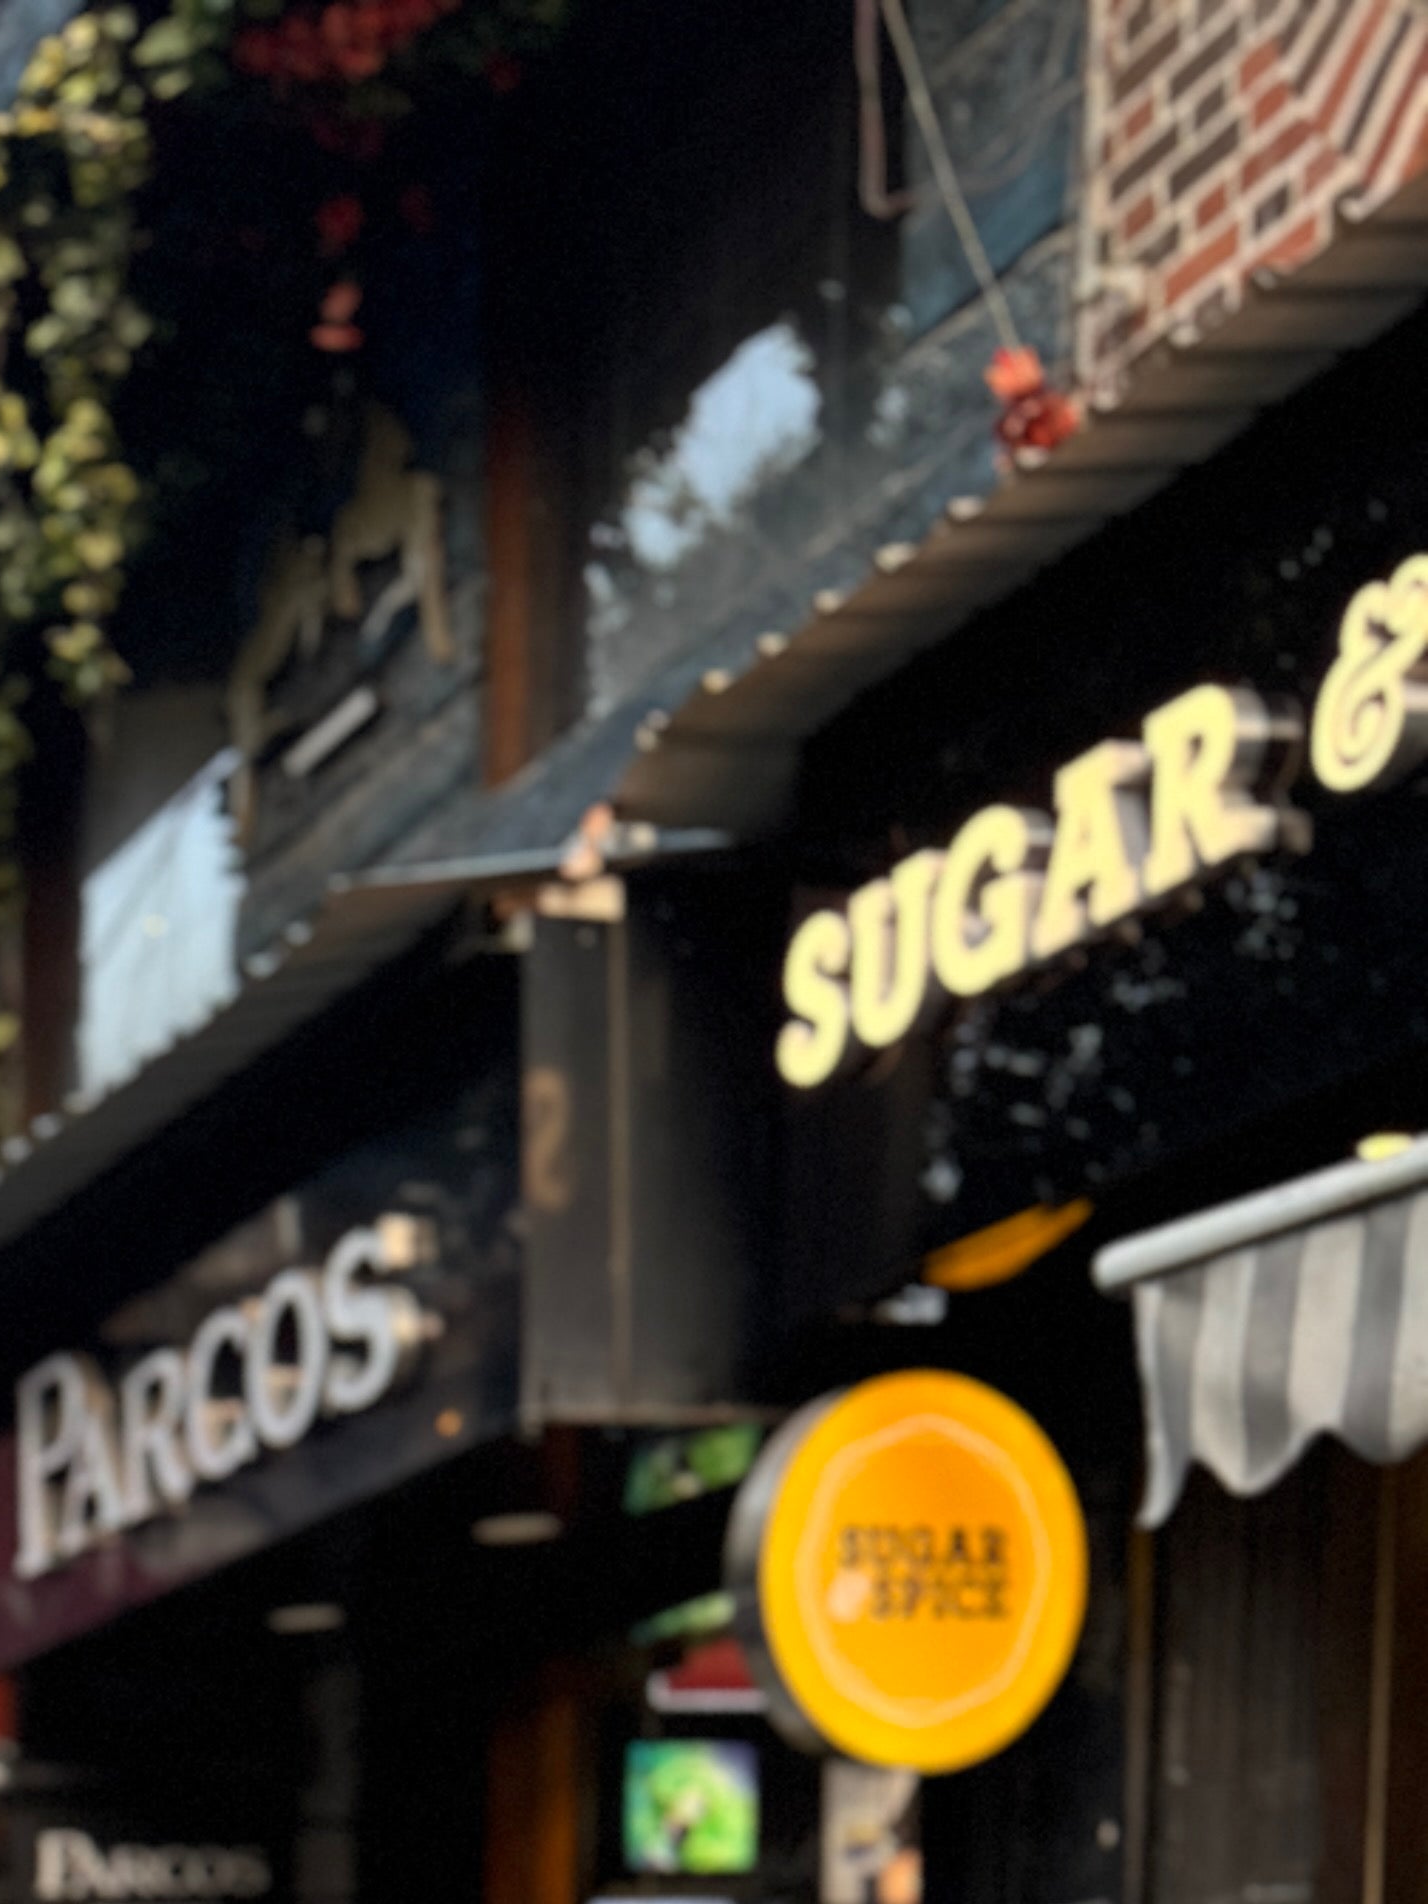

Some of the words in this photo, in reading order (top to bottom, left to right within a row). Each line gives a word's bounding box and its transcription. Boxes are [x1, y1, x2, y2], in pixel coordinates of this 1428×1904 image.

[776, 683, 1269, 1088] SUGAR
[1311, 553, 1428, 792] &
[14, 1227, 404, 1580] PARCOS
[842, 1525, 1008, 1567] SUGAR
[871, 1577, 1011, 1620] SPICE
